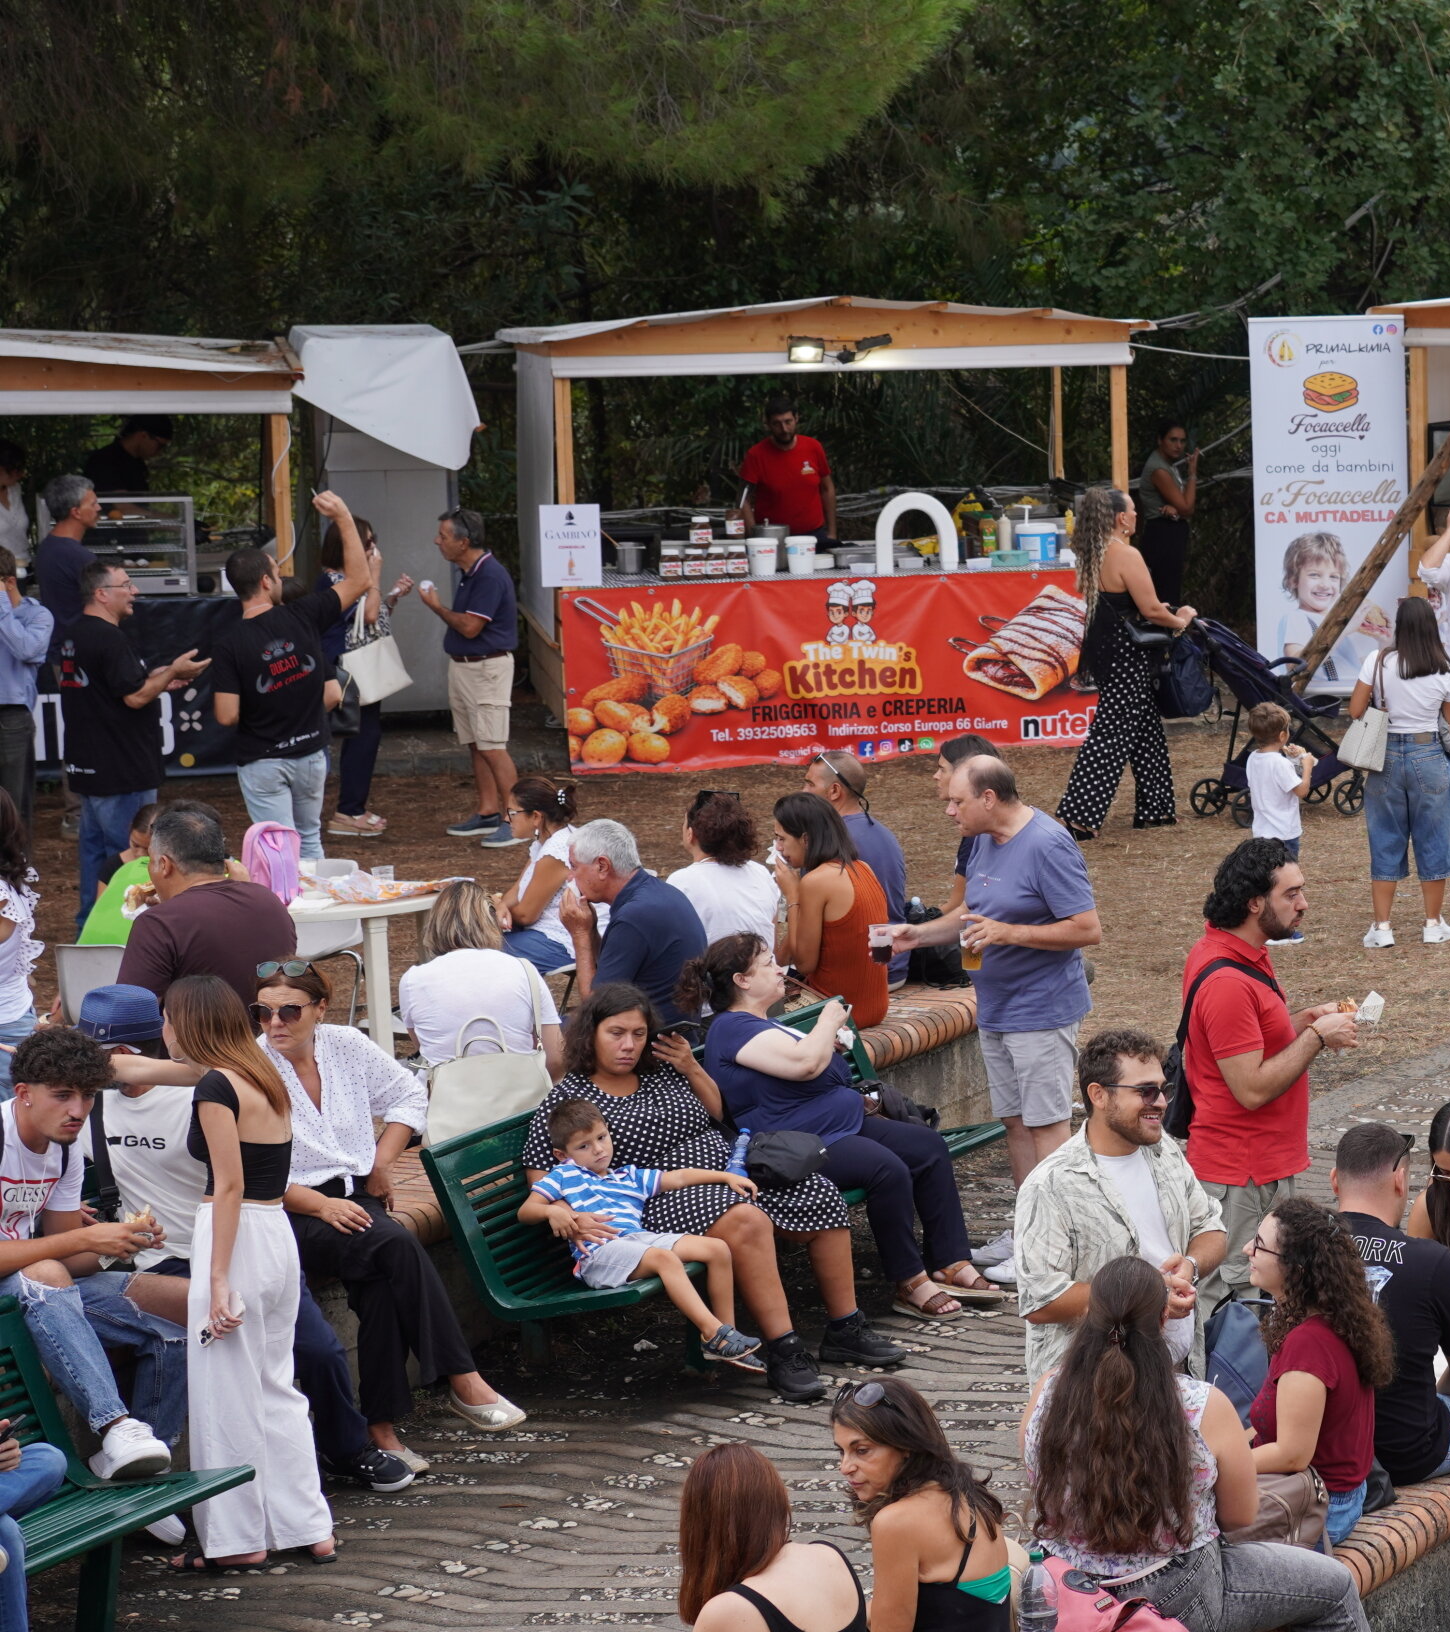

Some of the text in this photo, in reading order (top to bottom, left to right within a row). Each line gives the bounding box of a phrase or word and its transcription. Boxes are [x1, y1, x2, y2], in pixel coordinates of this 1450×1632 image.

[1305, 342, 1392, 354] PRIMALKIMIA
[1288, 413, 1372, 435] Focaccella
[1311, 443, 1341, 457] oggi
[1265, 459, 1394, 474] come da bambini
[1295, 509, 1397, 524] MUTTADELLA
[545, 529, 597, 540] GAMBINO
[804, 641, 912, 662] The Twin's
[269, 655, 299, 676] DUCATI
[788, 659, 917, 695] Kitchen
[752, 698, 967, 722] FRIGGITORIA e CREPERIA
[710, 717, 1008, 742] Tel. 3932509563 Indirizzo: Corso Europa 66 Giarre
[124, 1135, 166, 1150] GAS
[3, 1186, 48, 1203] GUESS
[1350, 1234, 1407, 1265] ORK
